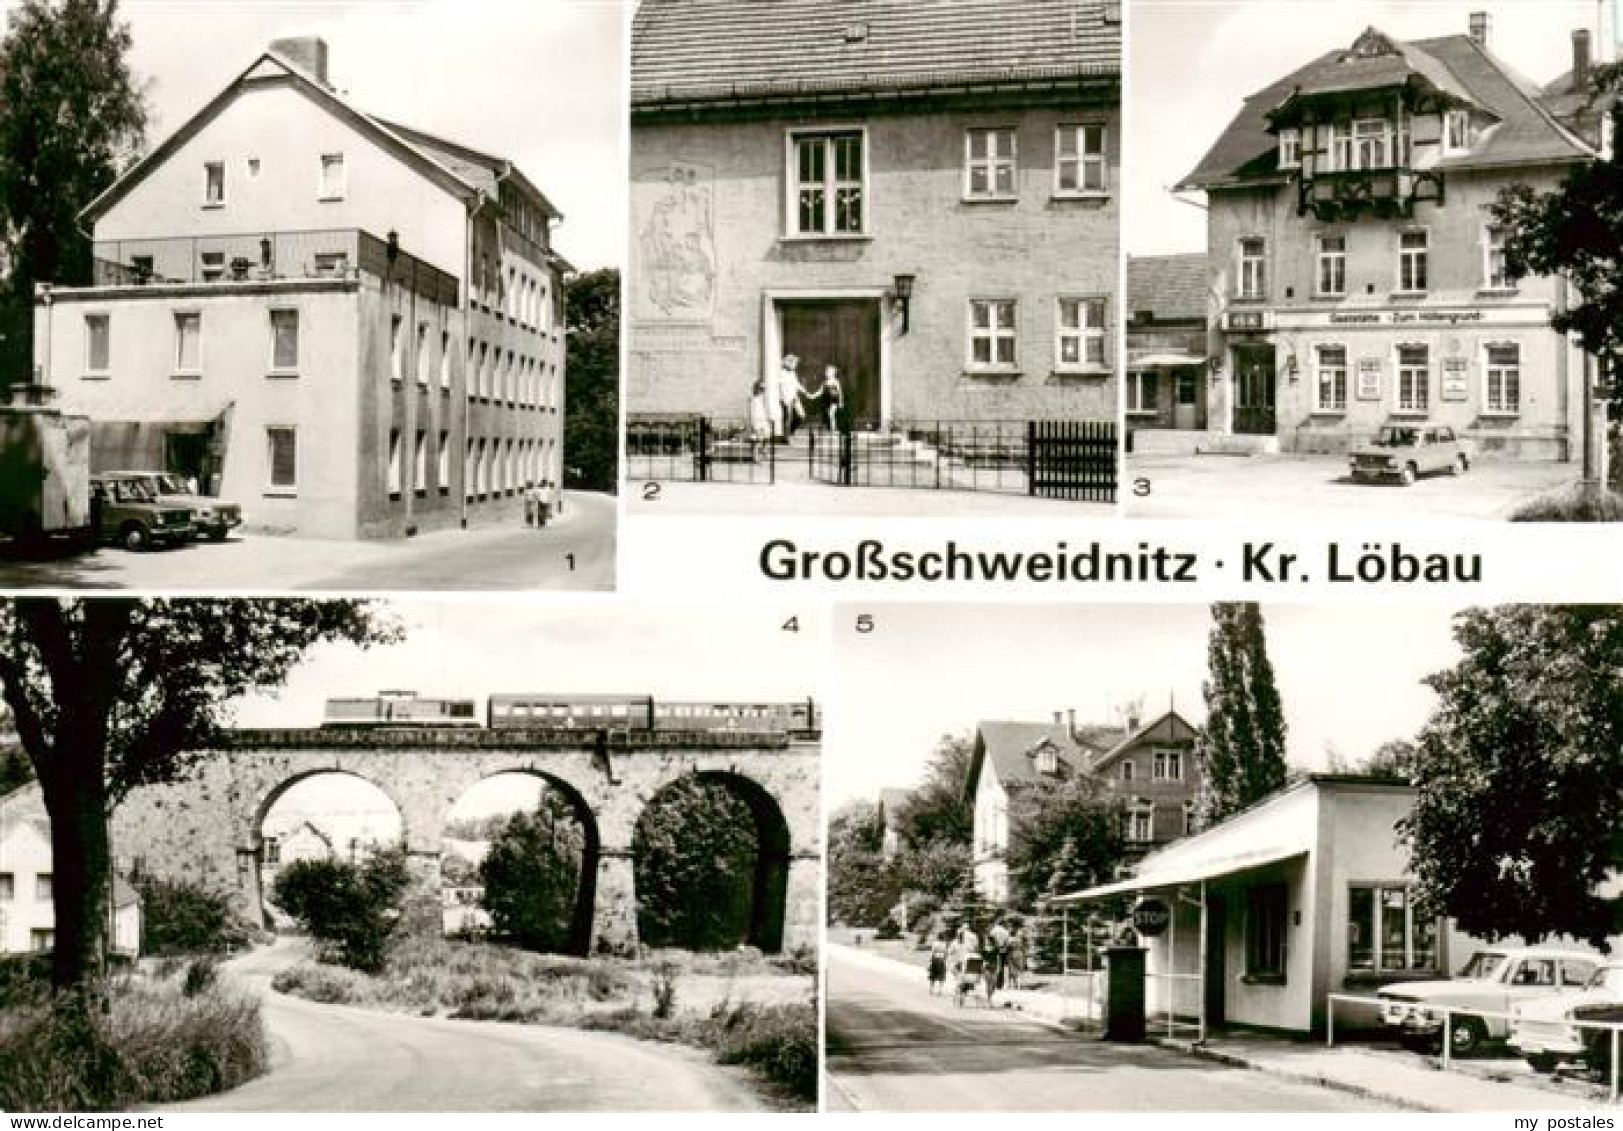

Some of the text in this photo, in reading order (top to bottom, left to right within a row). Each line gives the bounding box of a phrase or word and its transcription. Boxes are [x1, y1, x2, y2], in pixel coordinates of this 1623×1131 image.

[643, 481, 661, 501] 2
[1134, 477, 1151, 497] 3
[565, 553, 574, 571] 1
[759, 540, 1197, 583] Großschweidnitz
[1242, 542, 1309, 583] Kr.
[1328, 542, 1482, 583] Löbau
[781, 616, 799, 632] 4
[855, 615, 875, 633] 5
[1135, 910, 1168, 925] STOP
